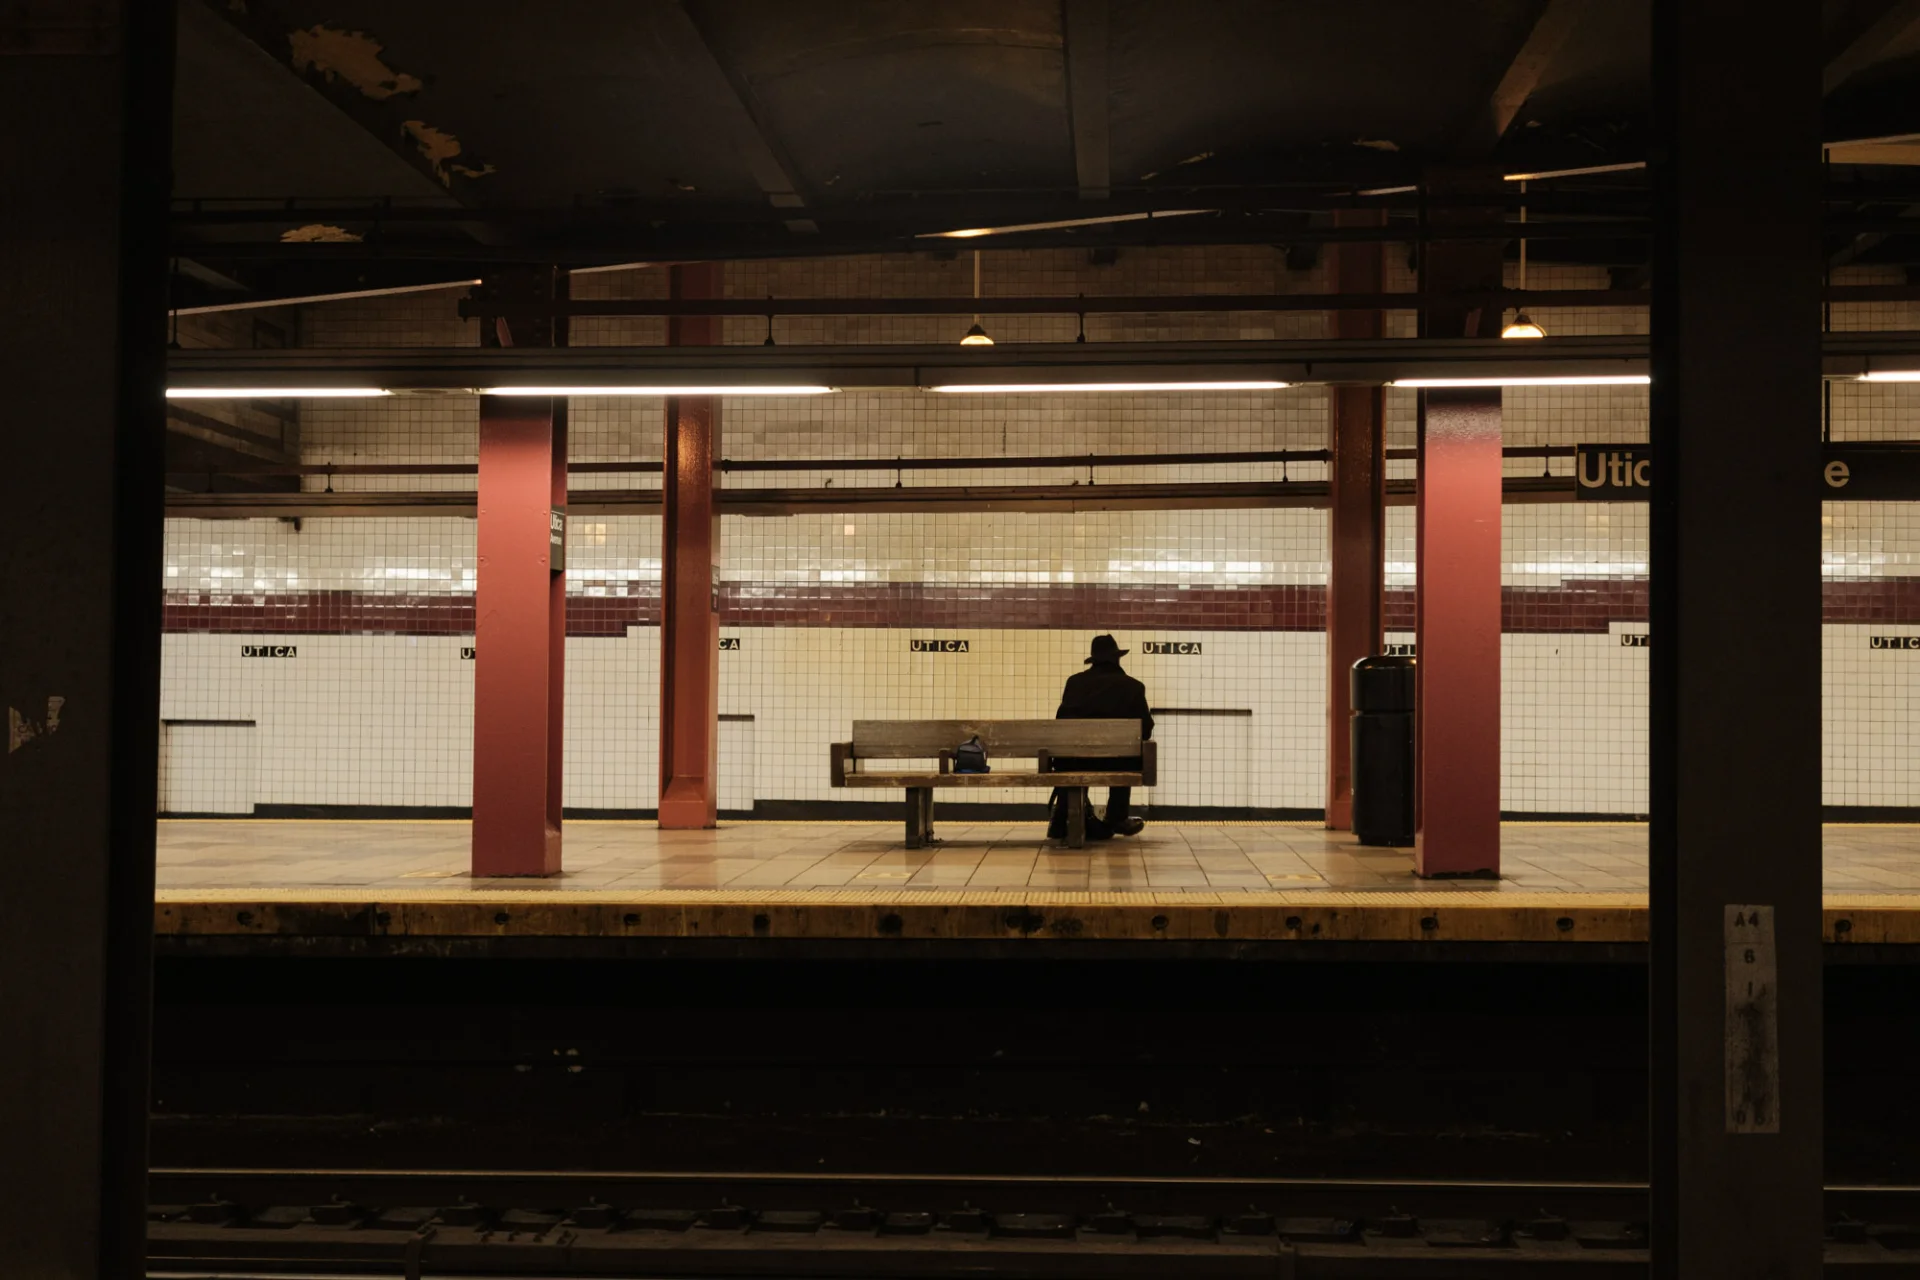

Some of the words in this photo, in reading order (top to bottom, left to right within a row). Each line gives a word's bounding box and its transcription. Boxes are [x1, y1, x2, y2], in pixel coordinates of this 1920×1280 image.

[911, 641, 968, 652] UTICA
[1144, 643, 1201, 654] UTICA
[1871, 637, 1920, 649] UTIC
[242, 646, 296, 657] UTICA
[1734, 911, 1759, 927] A4
[1744, 949, 1755, 964] 6
